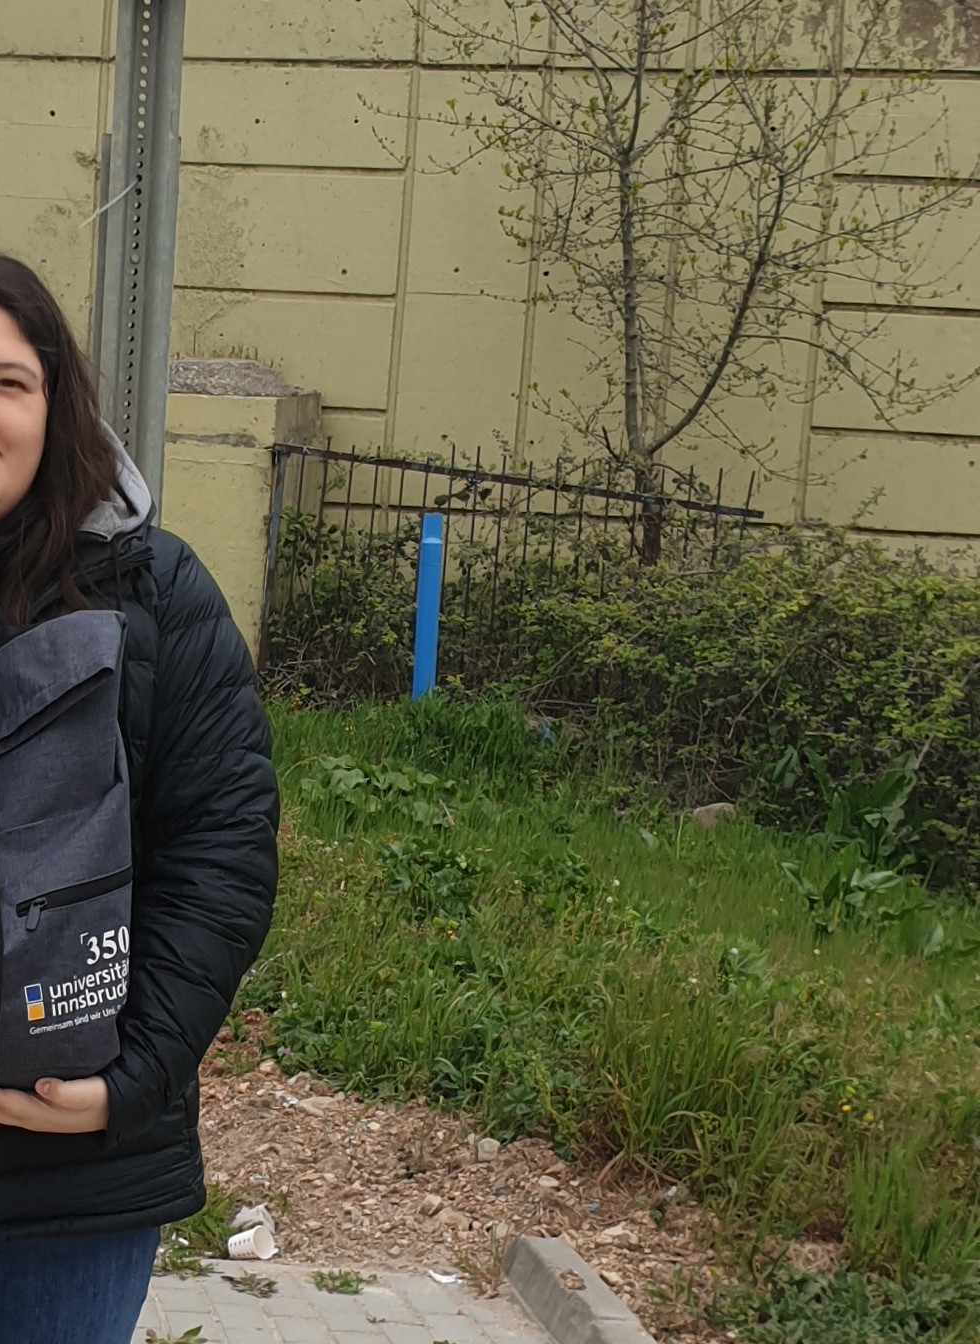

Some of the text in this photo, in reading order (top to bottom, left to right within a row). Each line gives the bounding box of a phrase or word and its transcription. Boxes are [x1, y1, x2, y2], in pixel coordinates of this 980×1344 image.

[86, 925, 130, 965] 350
[29, 1020, 74, 1035] Gemeinsam
[74, 1013, 89, 1026] sind
